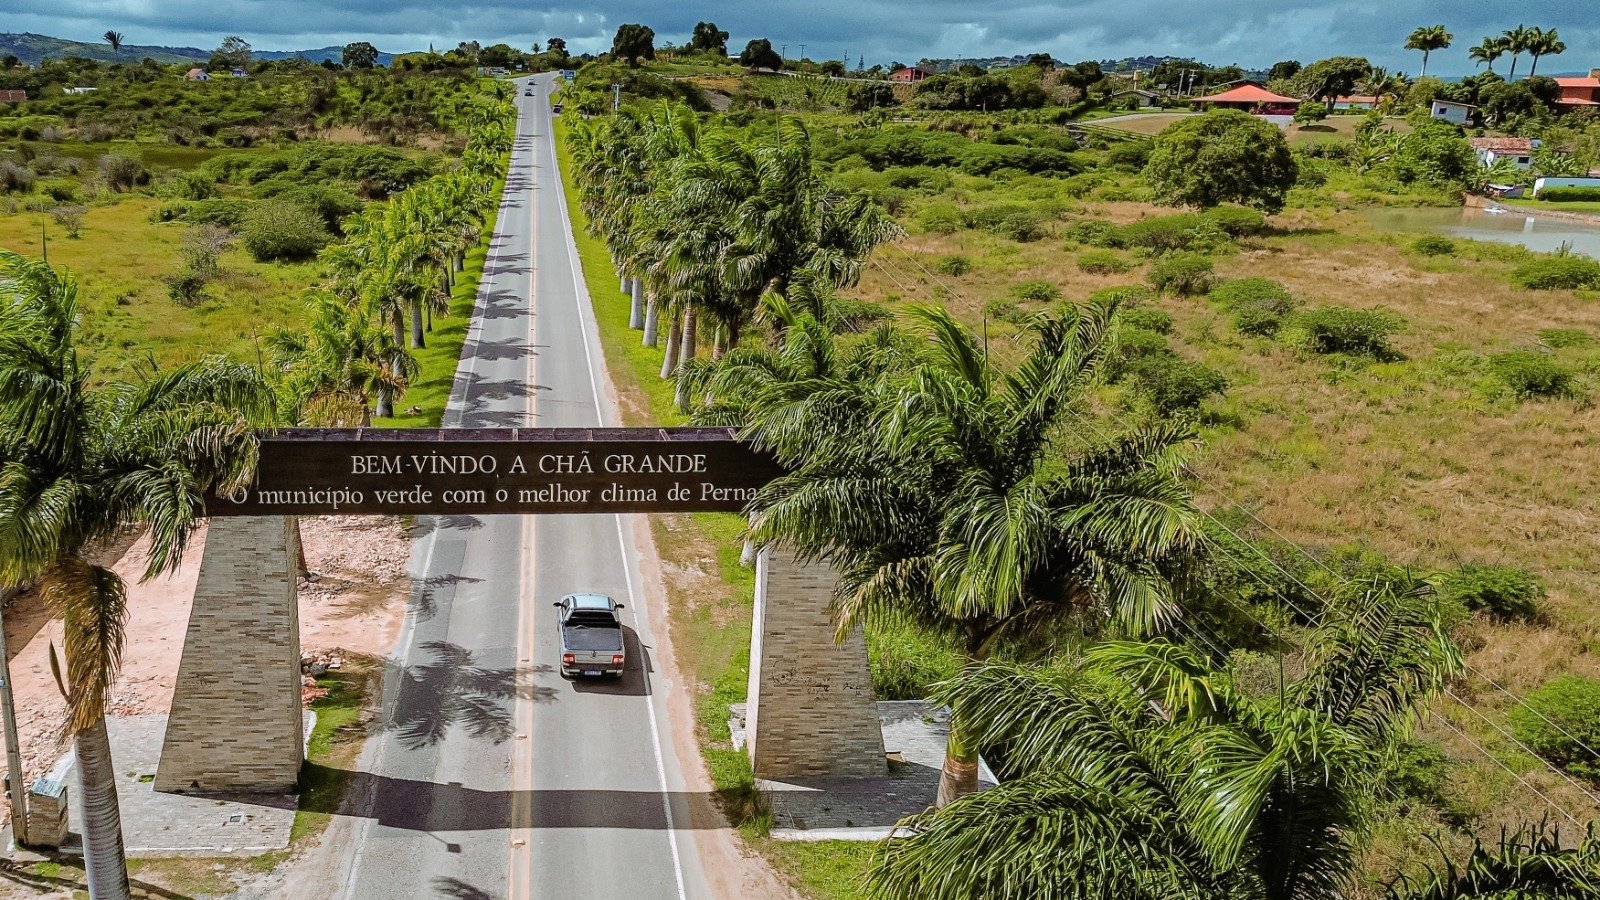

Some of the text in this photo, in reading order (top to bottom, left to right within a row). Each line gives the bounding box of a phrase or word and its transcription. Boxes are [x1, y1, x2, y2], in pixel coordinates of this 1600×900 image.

[509, 455, 527, 474] A
[539, 450, 594, 474] CHÃ
[604, 454, 707, 474] GRANDE
[229, 482, 759, 510] O município verde com o melhor clima de Perna
